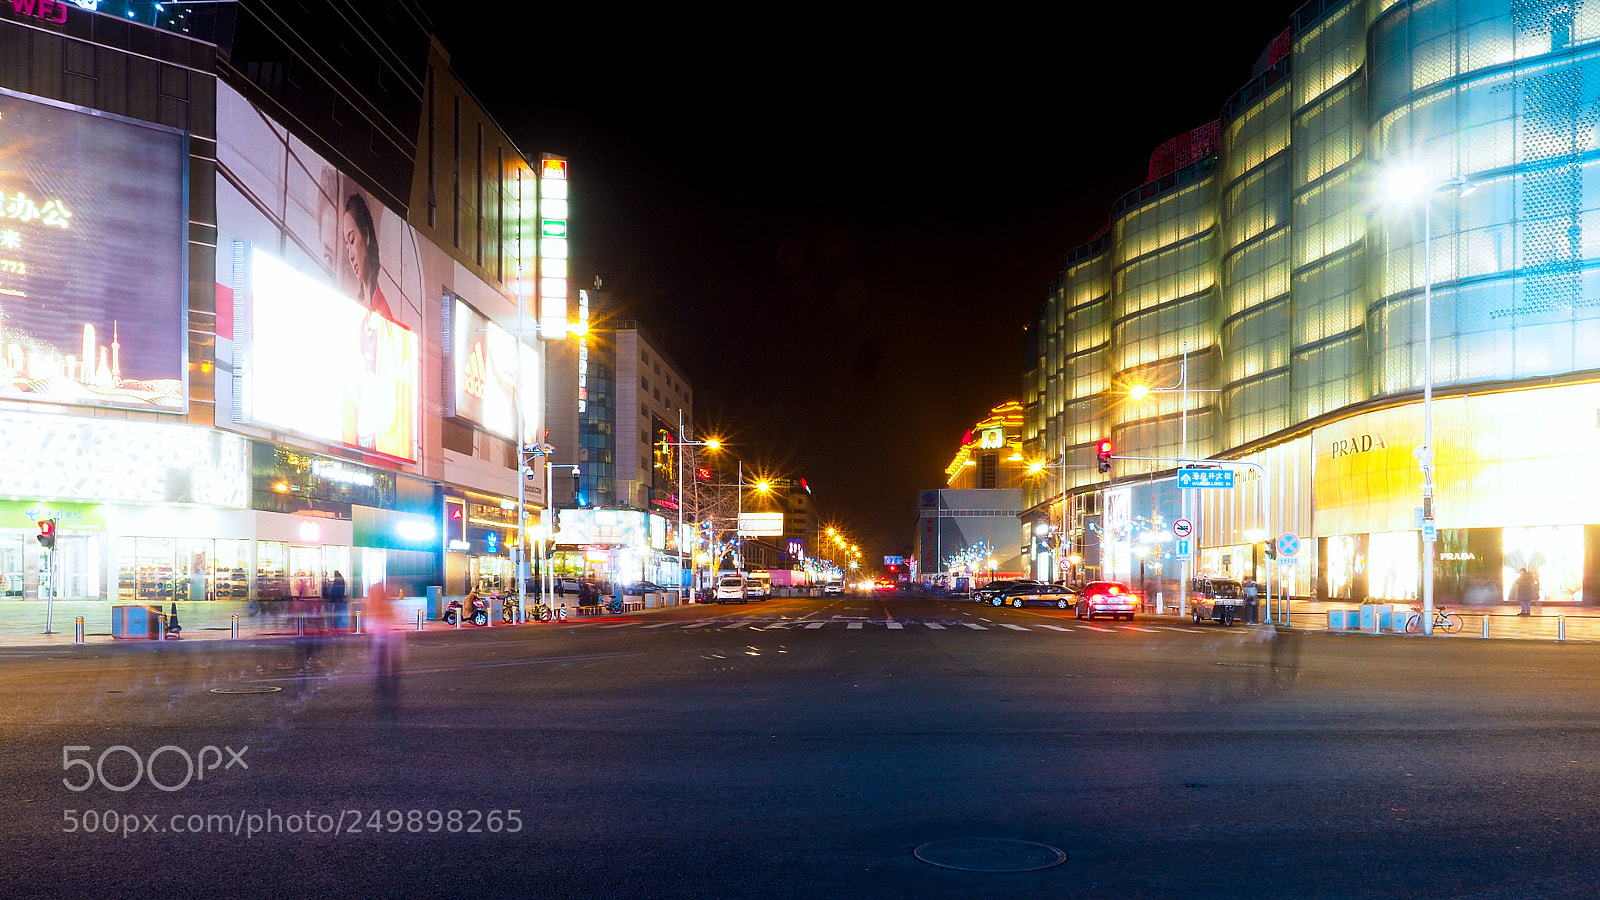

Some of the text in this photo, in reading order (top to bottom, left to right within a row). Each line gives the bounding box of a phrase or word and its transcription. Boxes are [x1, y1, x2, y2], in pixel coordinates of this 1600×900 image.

[12, 0, 67, 24] WFJ
[1332, 432, 1388, 459] PRADA
[1440, 552, 1475, 560] PRADA
